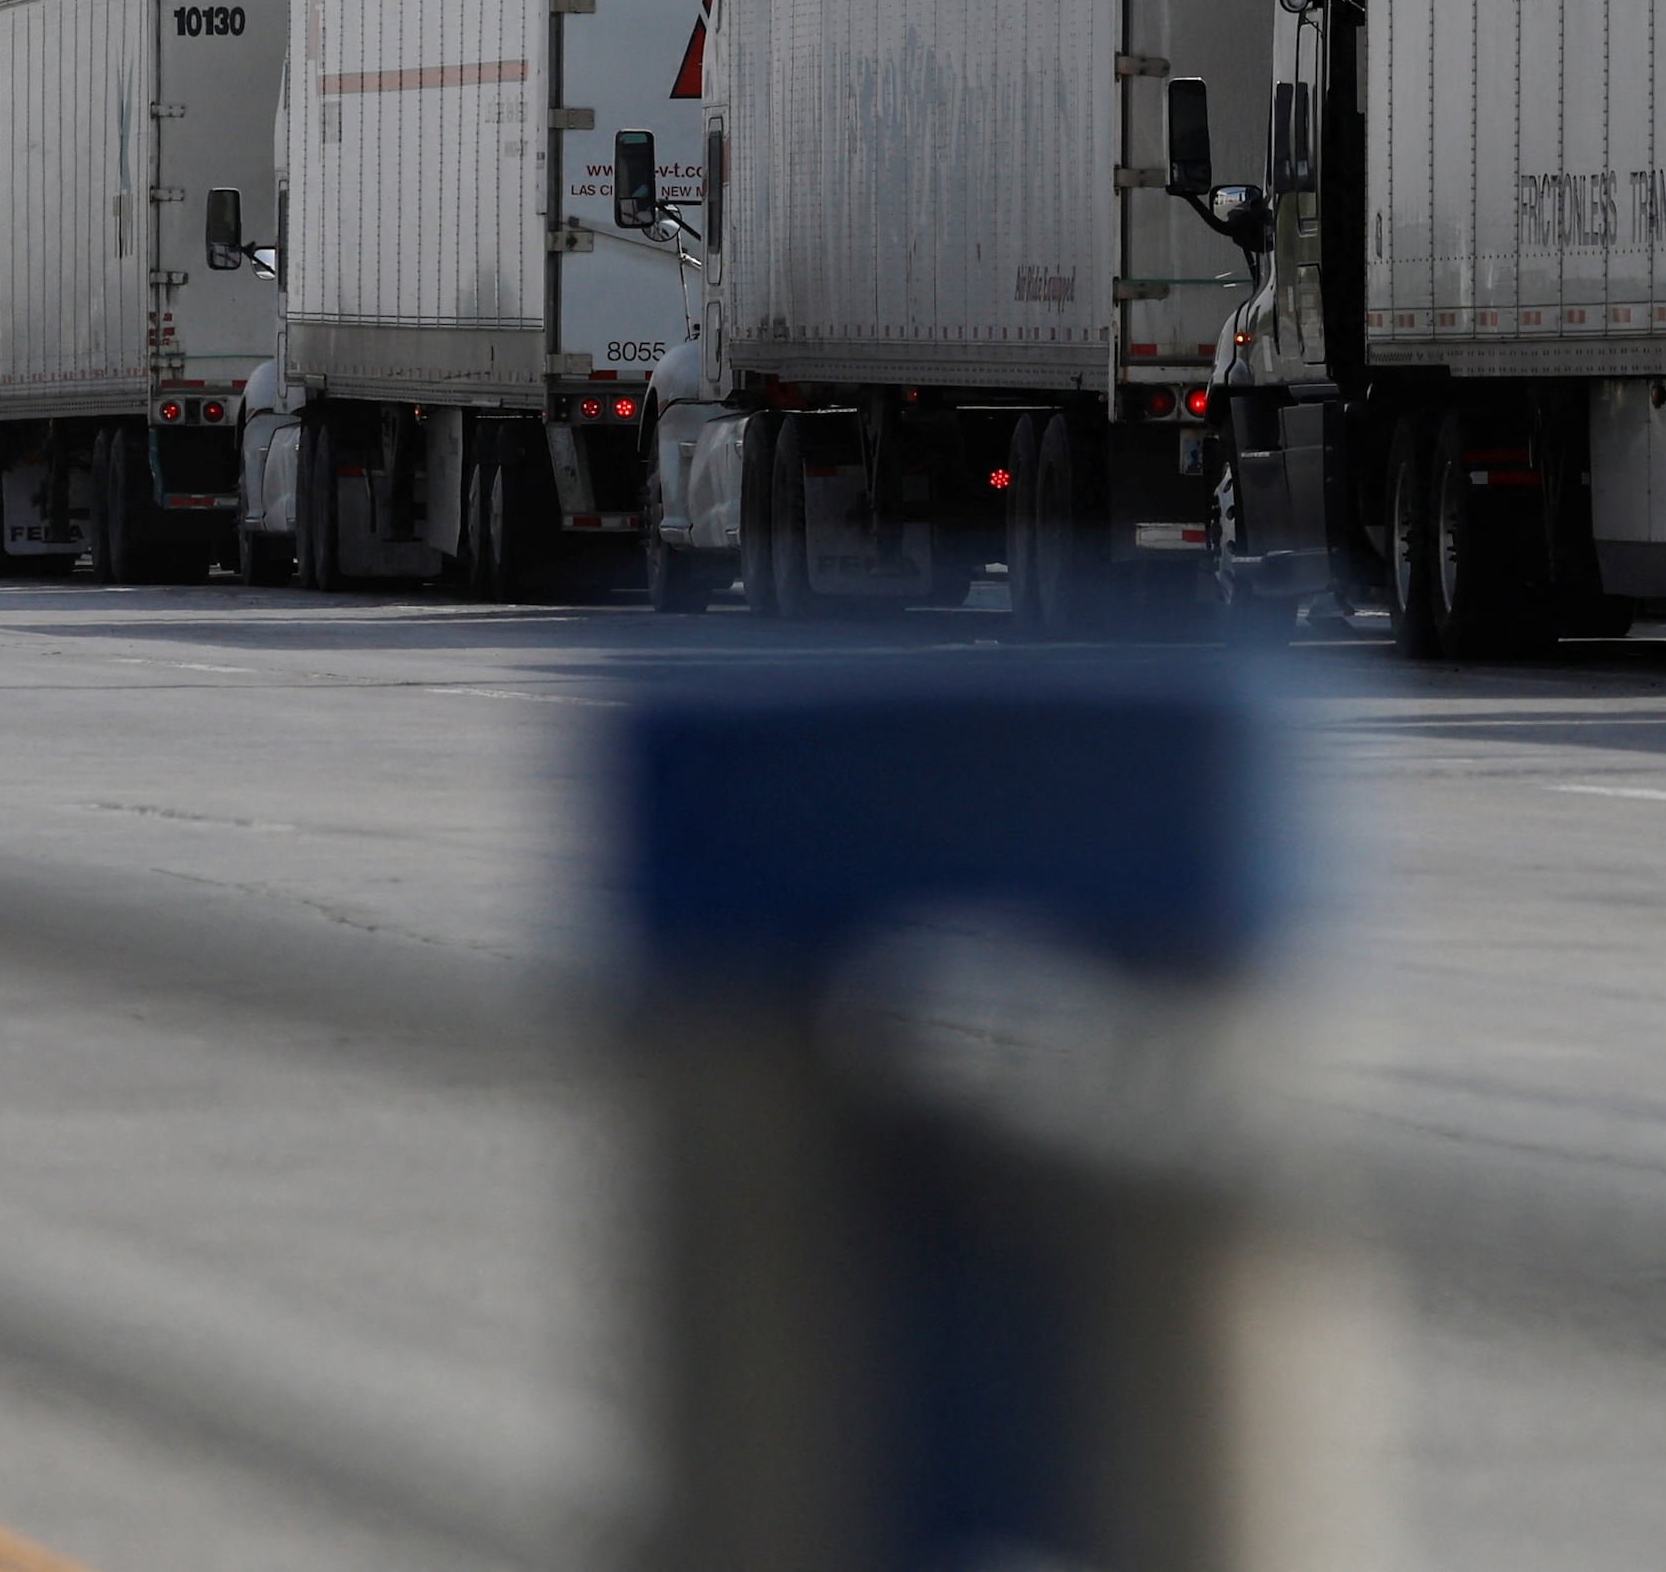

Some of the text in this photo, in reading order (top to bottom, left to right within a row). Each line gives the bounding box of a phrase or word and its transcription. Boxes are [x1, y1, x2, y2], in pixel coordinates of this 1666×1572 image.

[174, 7, 245, 37] 10130
[571, 185, 596, 196] LAS
[661, 186, 692, 197] NEW
[1521, 170, 1618, 247] FRICTIONLESS
[607, 342, 666, 361] 8055
